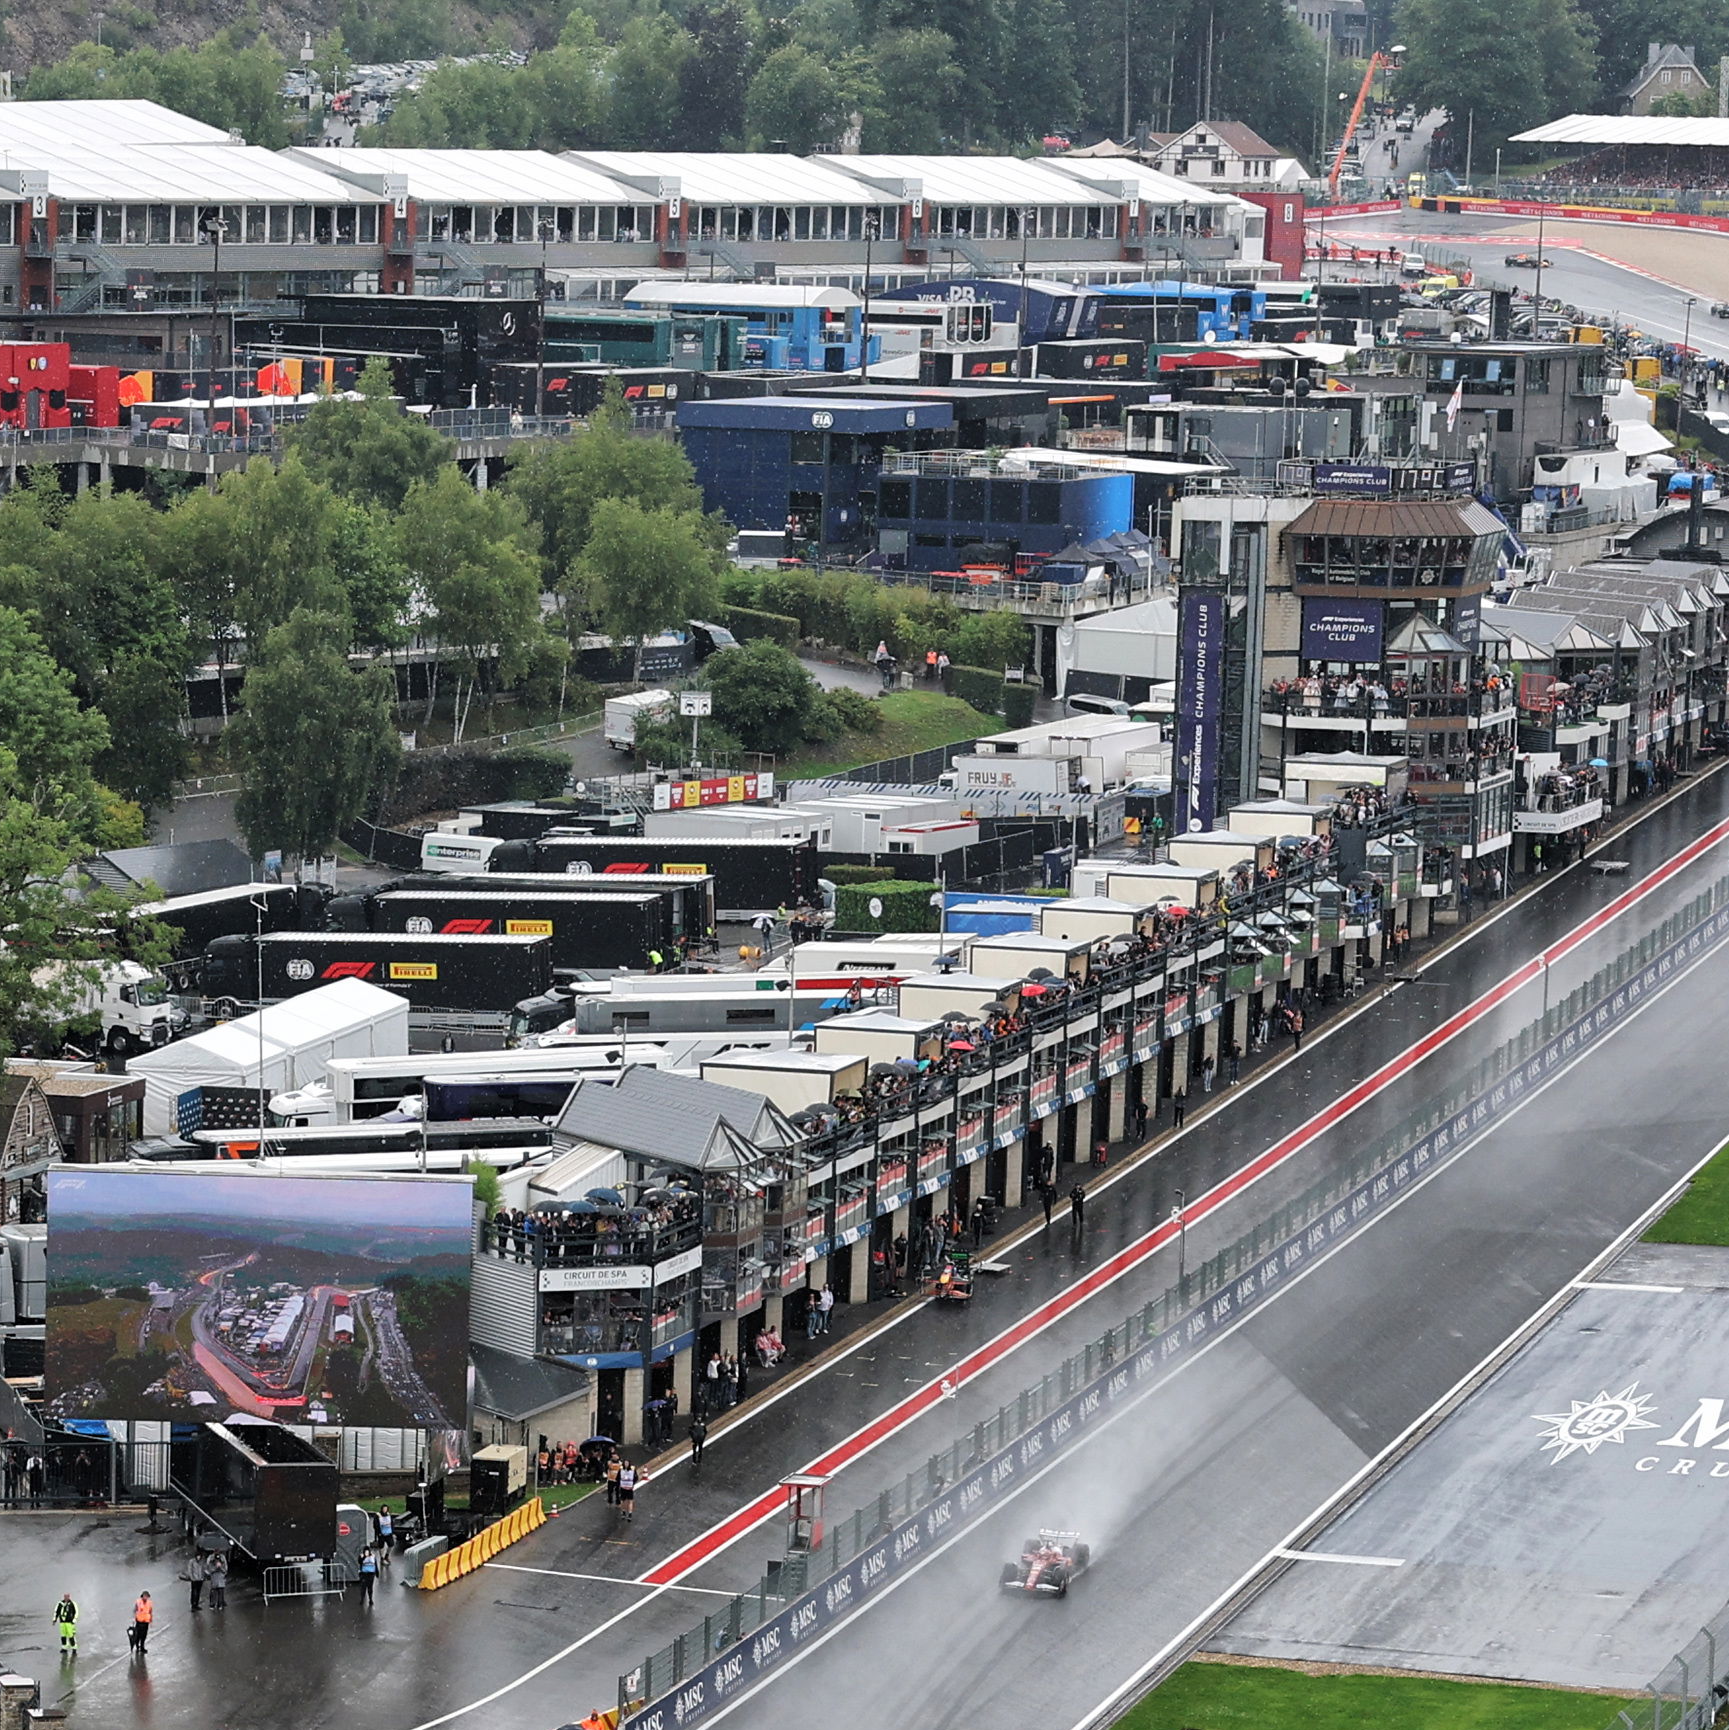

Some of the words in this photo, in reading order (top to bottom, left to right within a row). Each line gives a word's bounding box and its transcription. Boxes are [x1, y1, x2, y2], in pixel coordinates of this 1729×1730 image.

[36, 197, 42, 215] 3
[397, 198, 403, 215] 4
[813, 413, 833, 427] FIA
[1316, 476, 1364, 485] CHAMPIONS
[1366, 478, 1387, 486] CLUB
[1199, 604, 1208, 638] CLUB
[1310, 623, 1375, 635] CHAMPIONS
[1328, 632, 1356, 643] CLUB
[1195, 641, 1206, 718] CHAMPIONS
[1192, 724, 1203, 786] Experiences
[967, 772, 997, 784] FRUY
[433, 846, 481, 860] enterprise
[407, 918, 433, 933] FIA
[511, 922, 549, 934] PIRELLI
[287, 961, 314, 979] FIA
[394, 966, 433, 977] PIRELLI
[563, 1271, 597, 1281] CIRCUIT
[598, 1271, 609, 1279] DE
[610, 1270, 628, 1279] SPA
[796, 1599, 819, 1633] MSC
[758, 1627, 781, 1661] MSC
[722, 1653, 743, 1689] MSC
[682, 1681, 706, 1716] MSC
